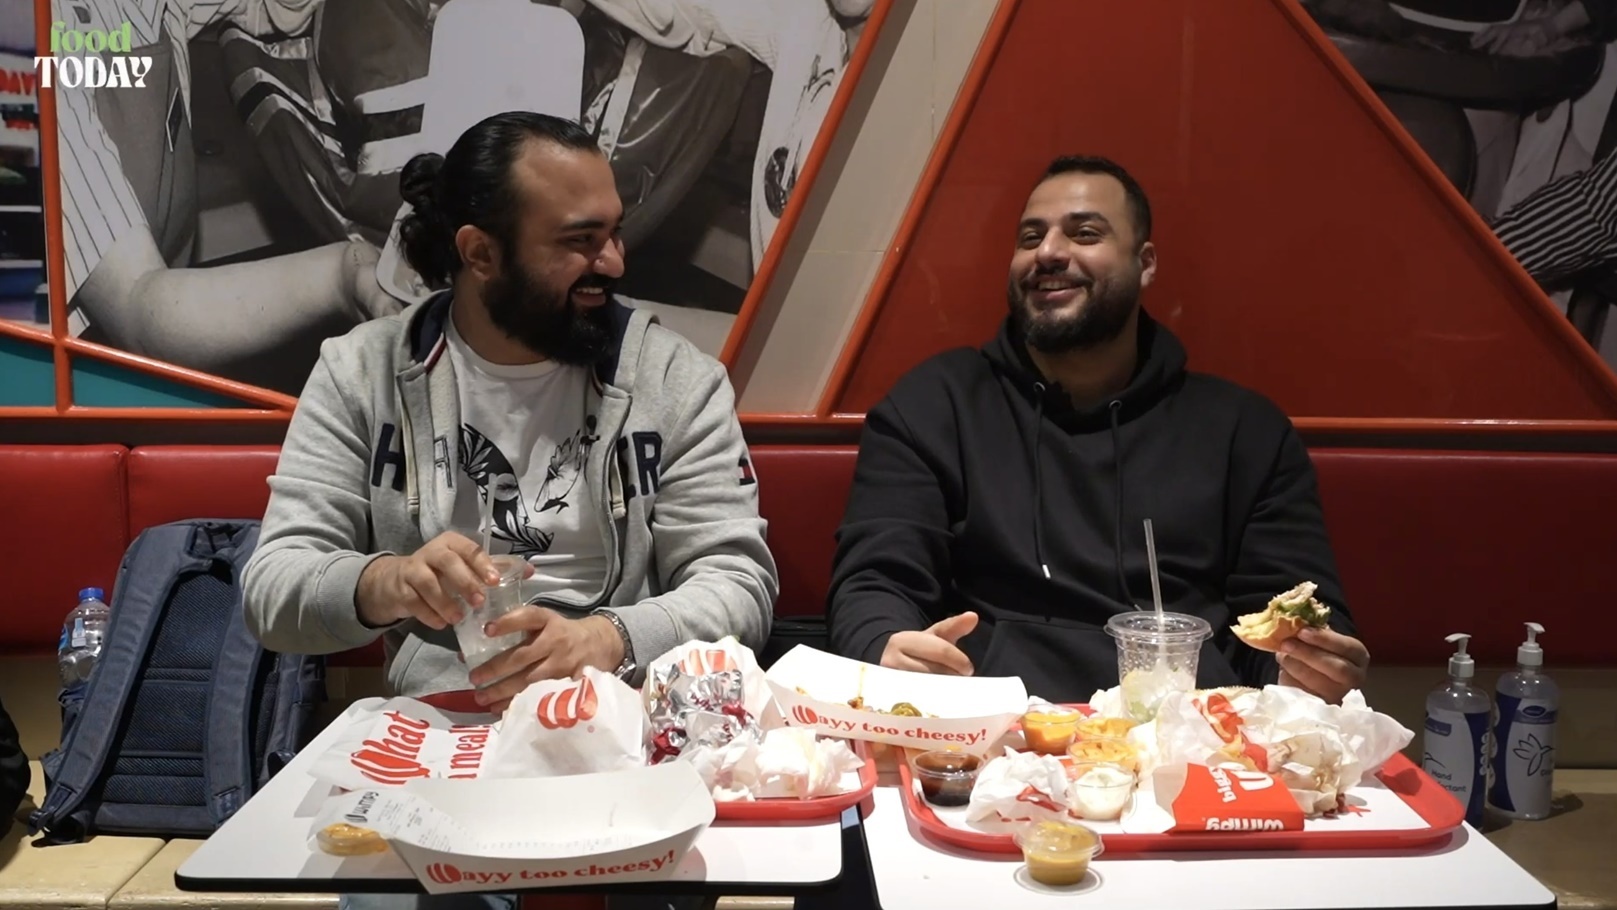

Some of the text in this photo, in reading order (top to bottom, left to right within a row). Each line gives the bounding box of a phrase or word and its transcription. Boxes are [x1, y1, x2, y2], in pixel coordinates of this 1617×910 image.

[792, 705, 987, 745] Wayy too cheesy!
[426, 850, 675, 884] Wayy too cheesy!
